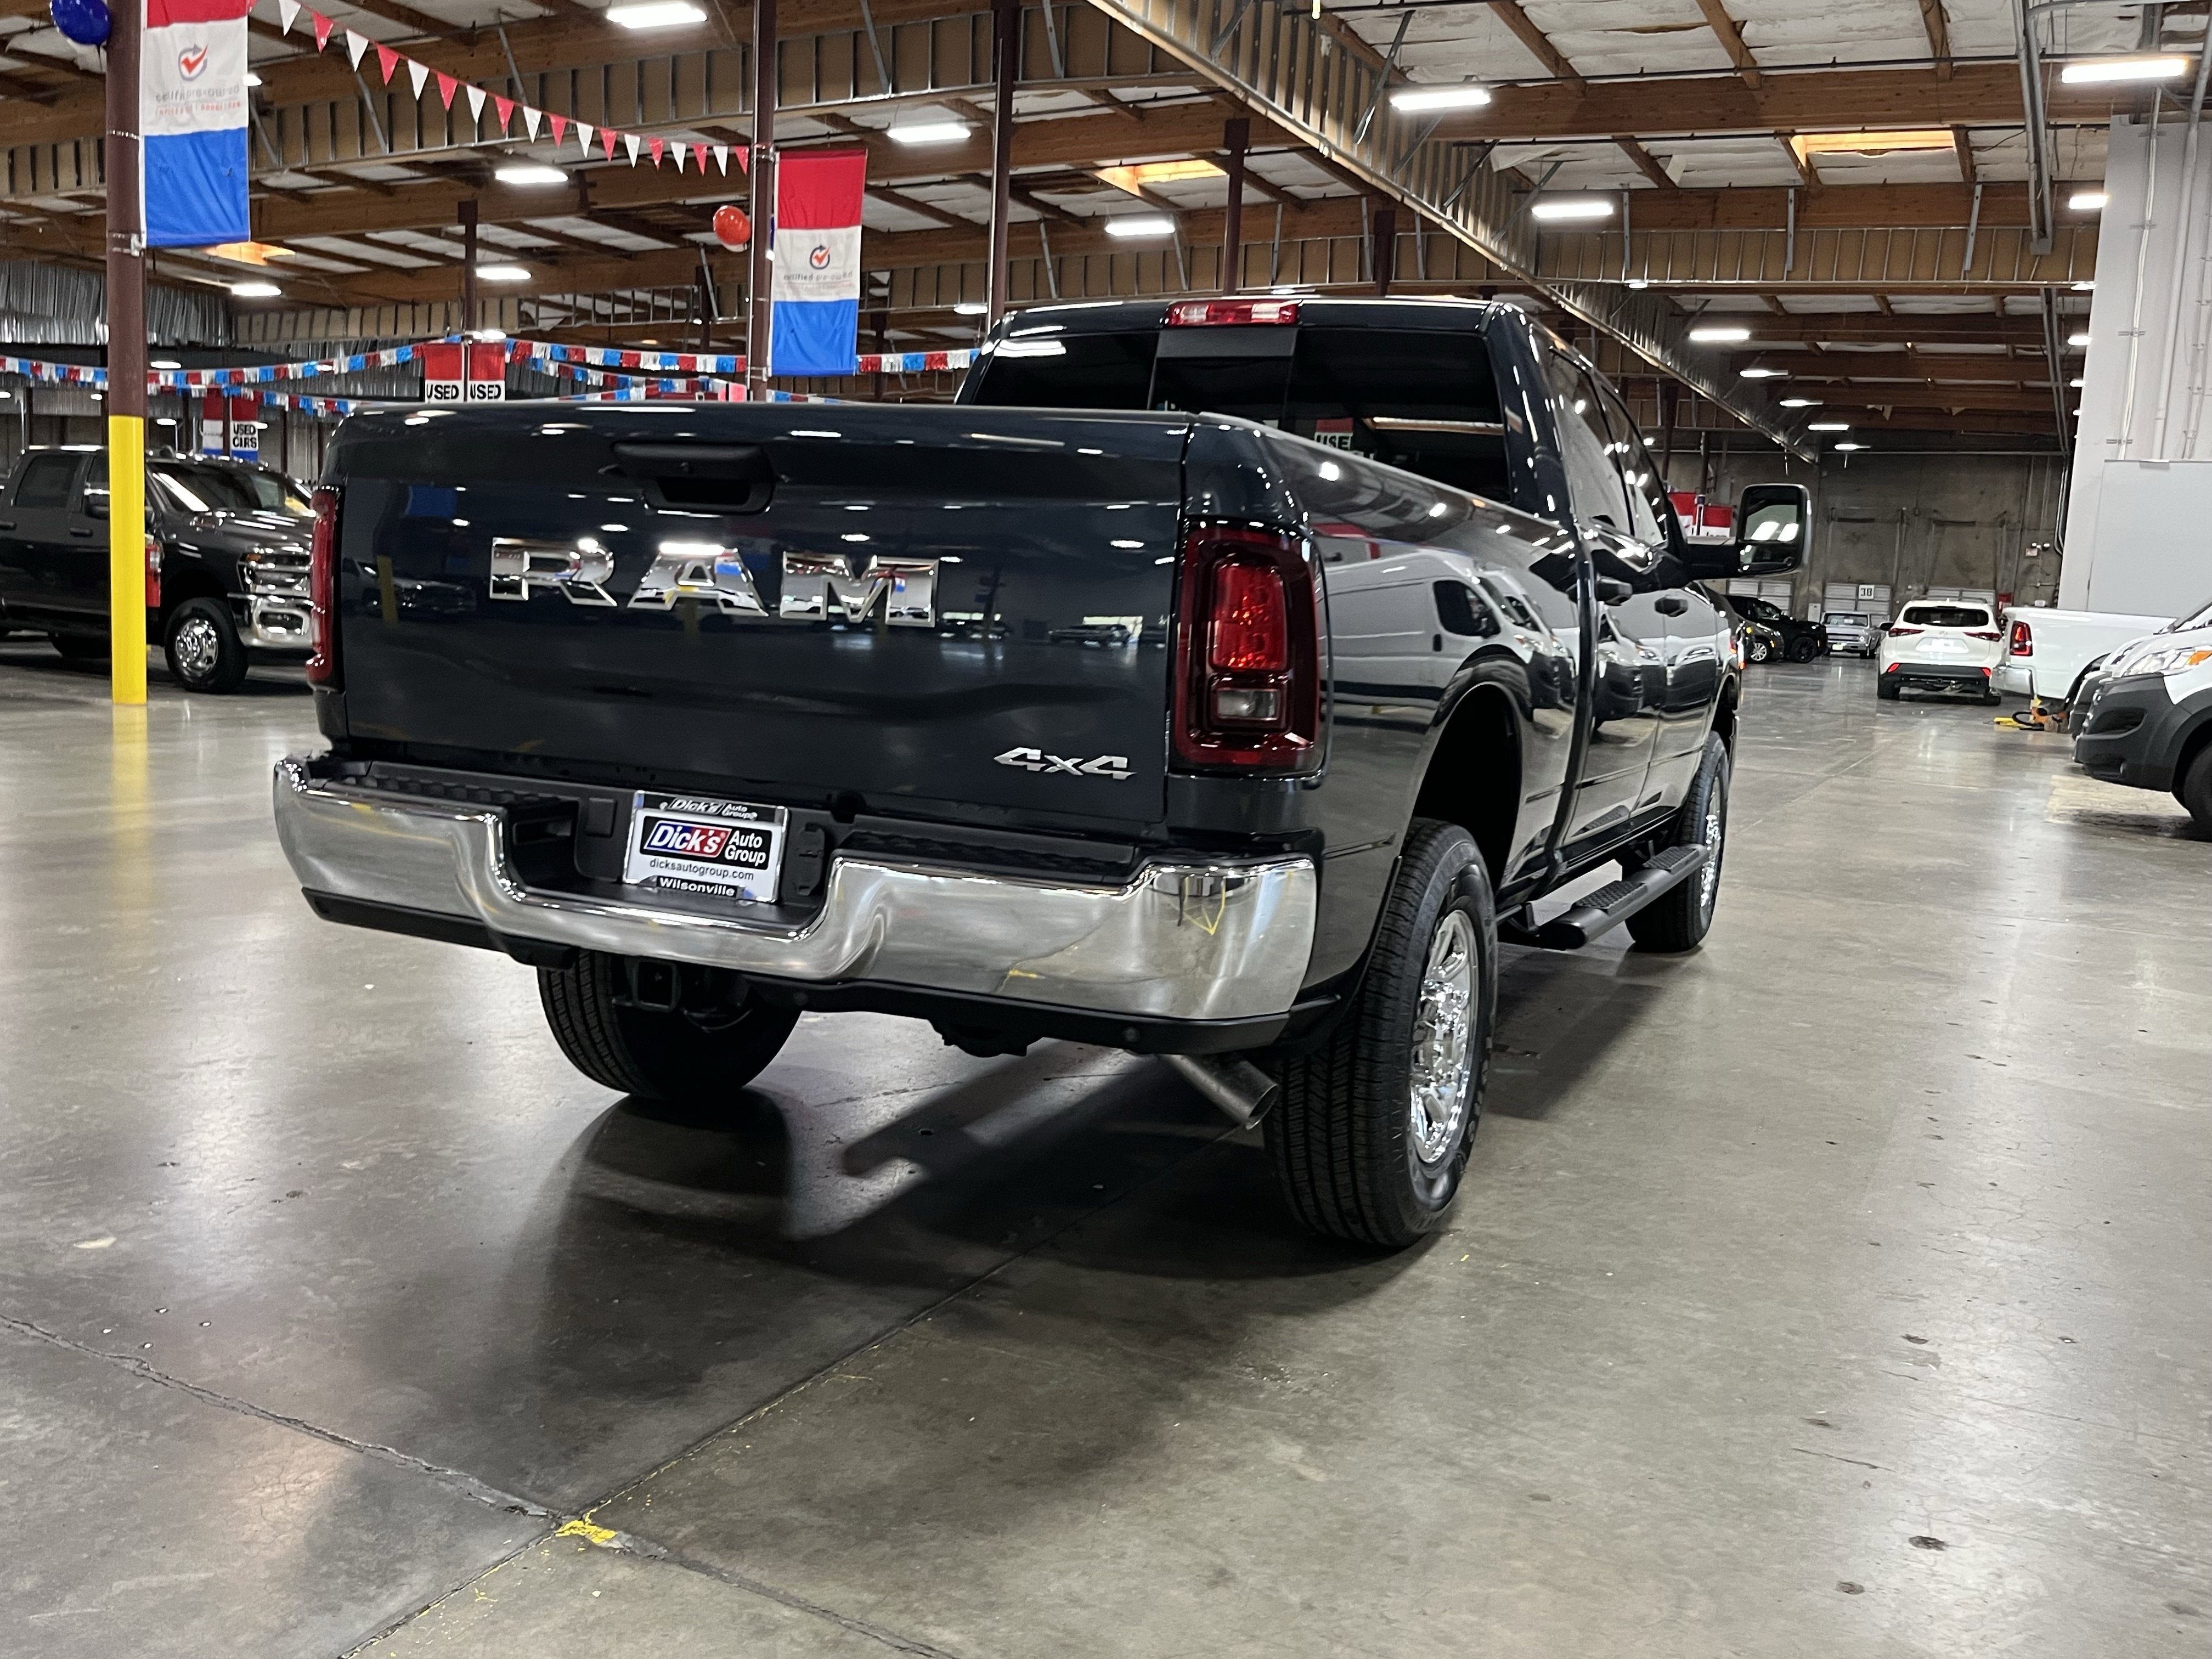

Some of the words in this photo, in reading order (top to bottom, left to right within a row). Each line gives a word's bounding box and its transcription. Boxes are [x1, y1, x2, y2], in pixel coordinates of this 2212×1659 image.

[426, 384, 459, 400] USED
[470, 384, 501, 400] USED
[233, 424, 256, 435] USED
[490, 537, 939, 628] RAM
[651, 825, 721, 854] Dick's
[729, 831, 763, 848] Auto
[724, 844, 766, 867] Group
[650, 858, 754, 881] dicksautogroup.com
[659, 877, 735, 897] Wilsonville
